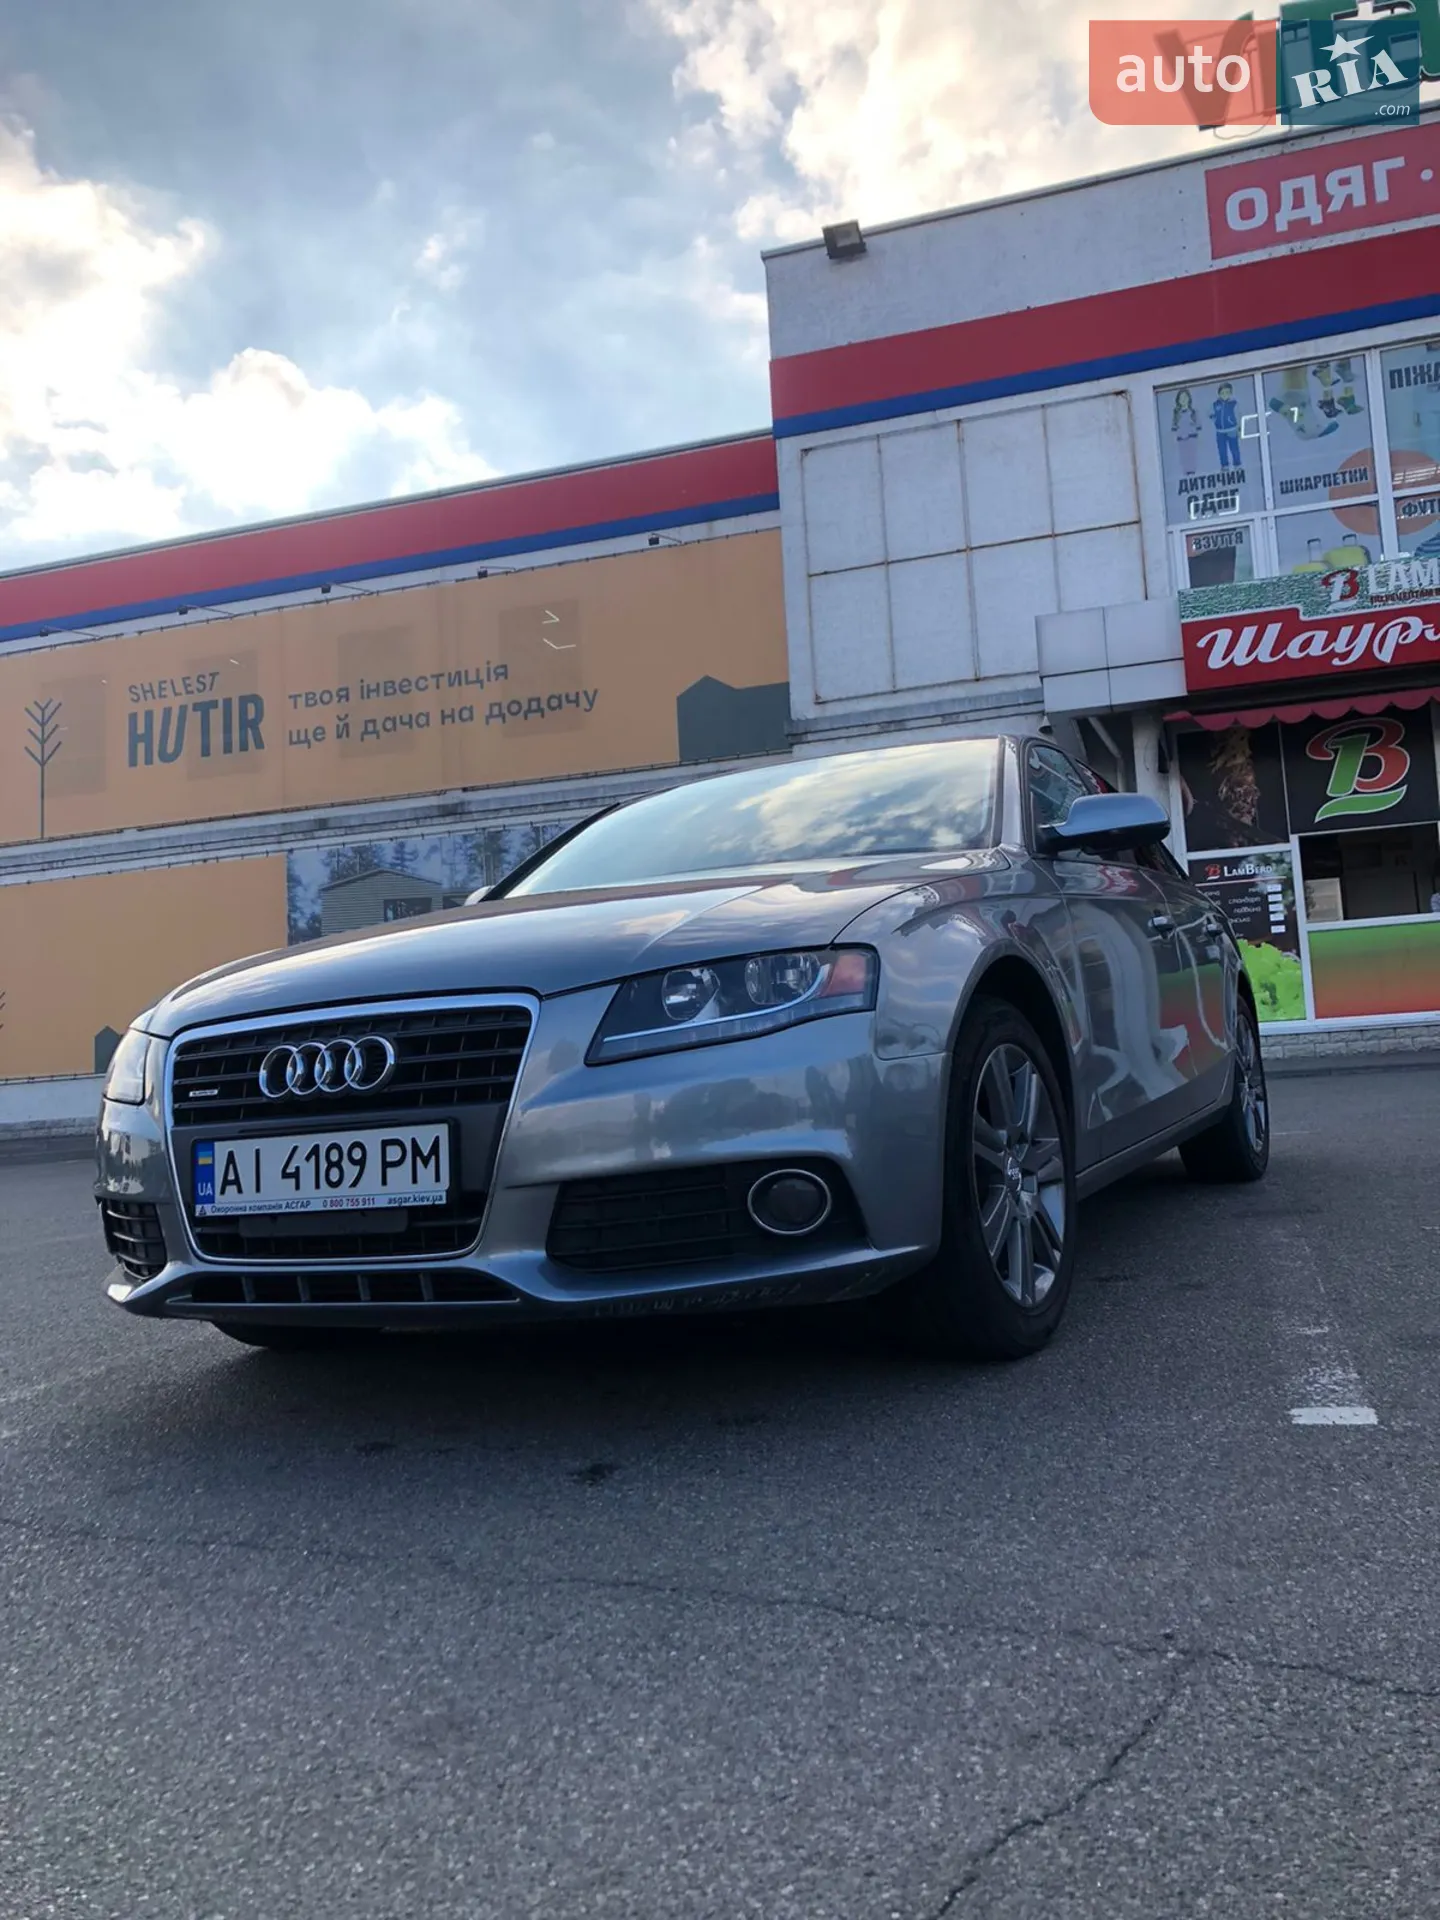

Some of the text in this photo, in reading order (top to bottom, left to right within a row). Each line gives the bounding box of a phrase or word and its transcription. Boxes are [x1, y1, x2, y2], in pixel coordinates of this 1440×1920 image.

[1225, 156, 1405, 232] ОДЯГ
[1178, 468, 1246, 496] ДИТЯЧИЙ
[1279, 466, 1368, 495] ШКАРПЕТКИ
[128, 671, 219, 703] SHELEST
[289, 661, 509, 710] твоя інвестиція
[127, 693, 265, 768] HUTIR
[288, 687, 599, 749] ще й дача на додачу
[281, 1141, 367, 1190] 4189
[381, 1135, 441, 1186] PM
[198, 1182, 213, 1196] UA
